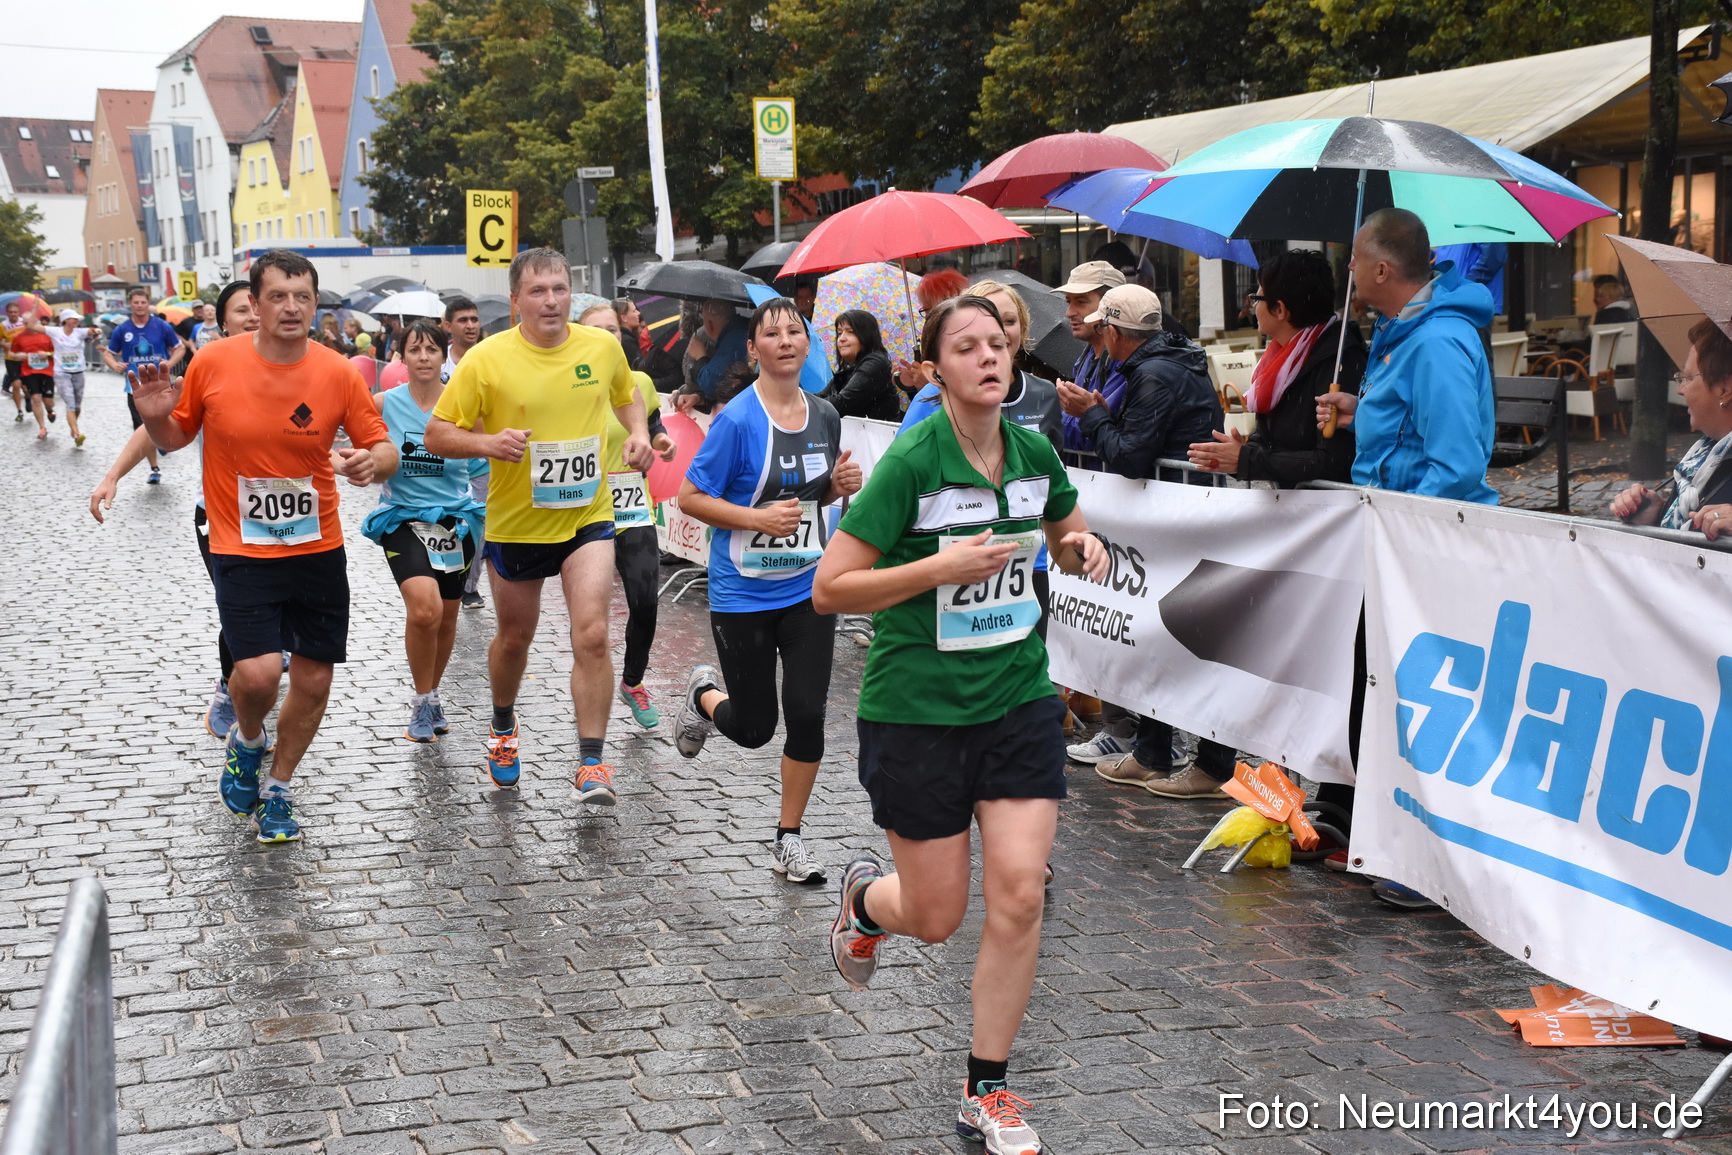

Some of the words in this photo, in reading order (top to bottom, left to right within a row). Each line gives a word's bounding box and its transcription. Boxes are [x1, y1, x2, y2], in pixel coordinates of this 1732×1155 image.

[473, 194, 512, 209] Block
[479, 214, 505, 251] C
[183, 281, 193, 295] D
[125, 332, 134, 343] 9
[401, 461, 444, 472] HIRSCH
[539, 453, 596, 484] 2796
[559, 490, 584, 500] Hans
[612, 487, 645, 509] 272
[248, 492, 312, 521] 2096
[965, 502, 983, 510] JAKO
[268, 526, 296, 537] Franz
[761, 556, 806, 568] Stefanie
[971, 613, 1014, 632] Andrea
[1048, 590, 1136, 647] AHRFREUDE.
[1247, 774, 1284, 812] BRANDING
